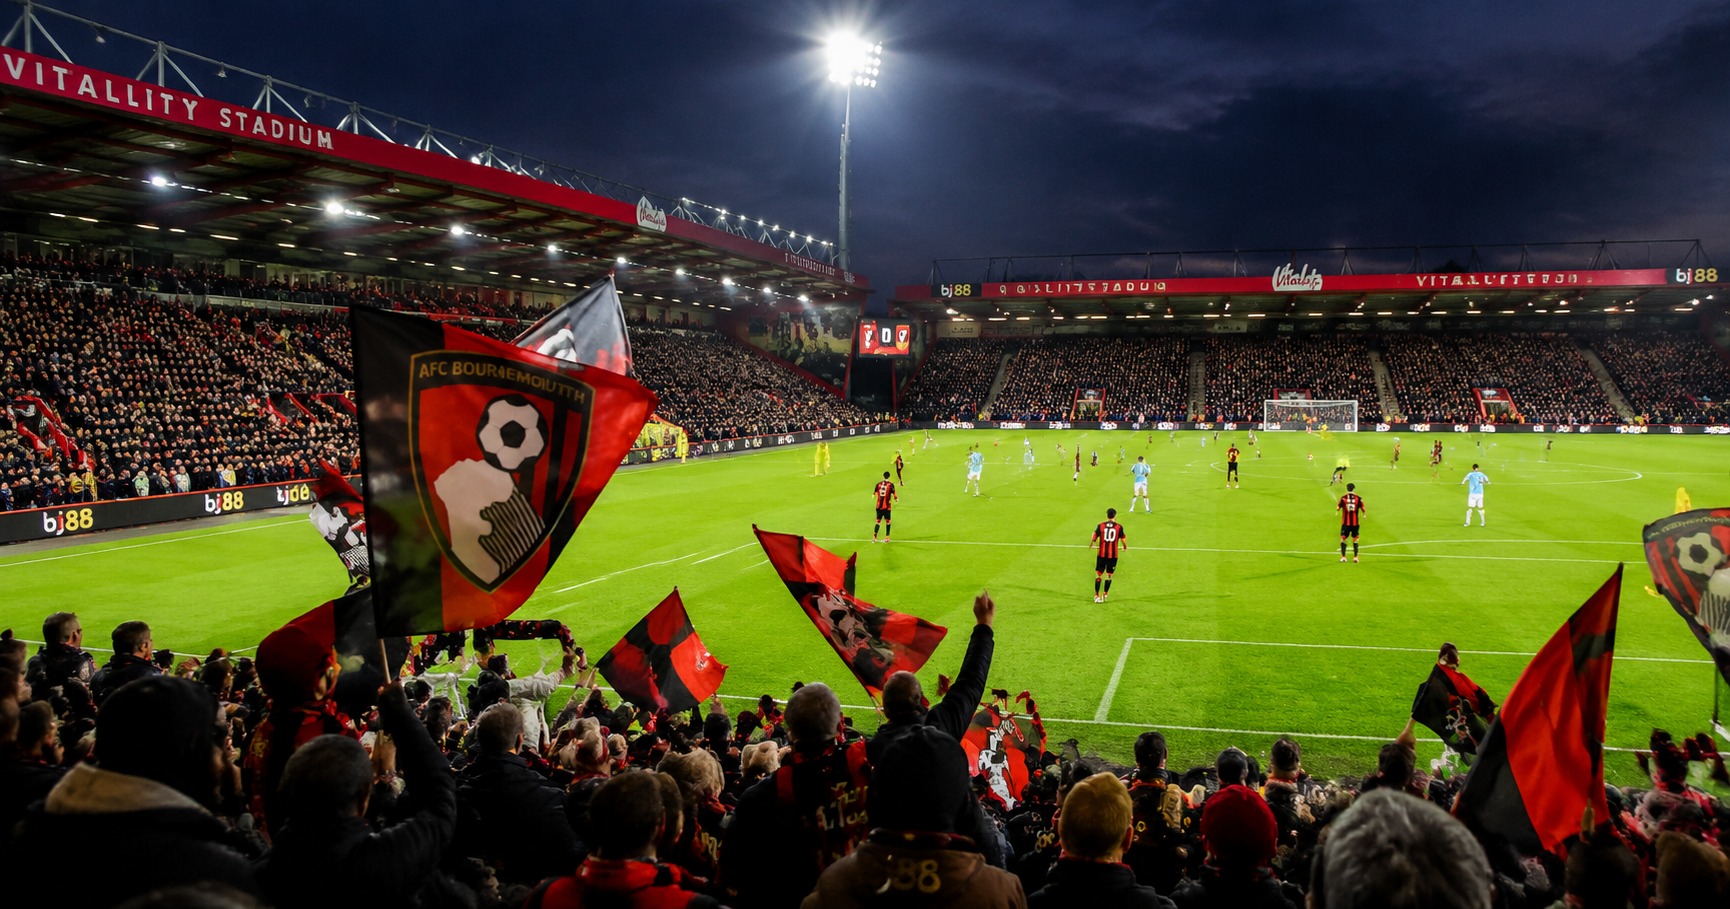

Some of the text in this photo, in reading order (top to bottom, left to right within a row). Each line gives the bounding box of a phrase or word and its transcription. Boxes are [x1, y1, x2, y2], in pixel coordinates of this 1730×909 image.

[3, 53, 335, 150] VITALLITY STADIUM
[1675, 267, 1718, 285] bj88
[941, 284, 971, 298] bj88
[419, 361, 448, 378] AFC
[204, 490, 244, 515] bj88
[42, 508, 94, 536] bj88
[1103, 527, 1117, 543] 10
